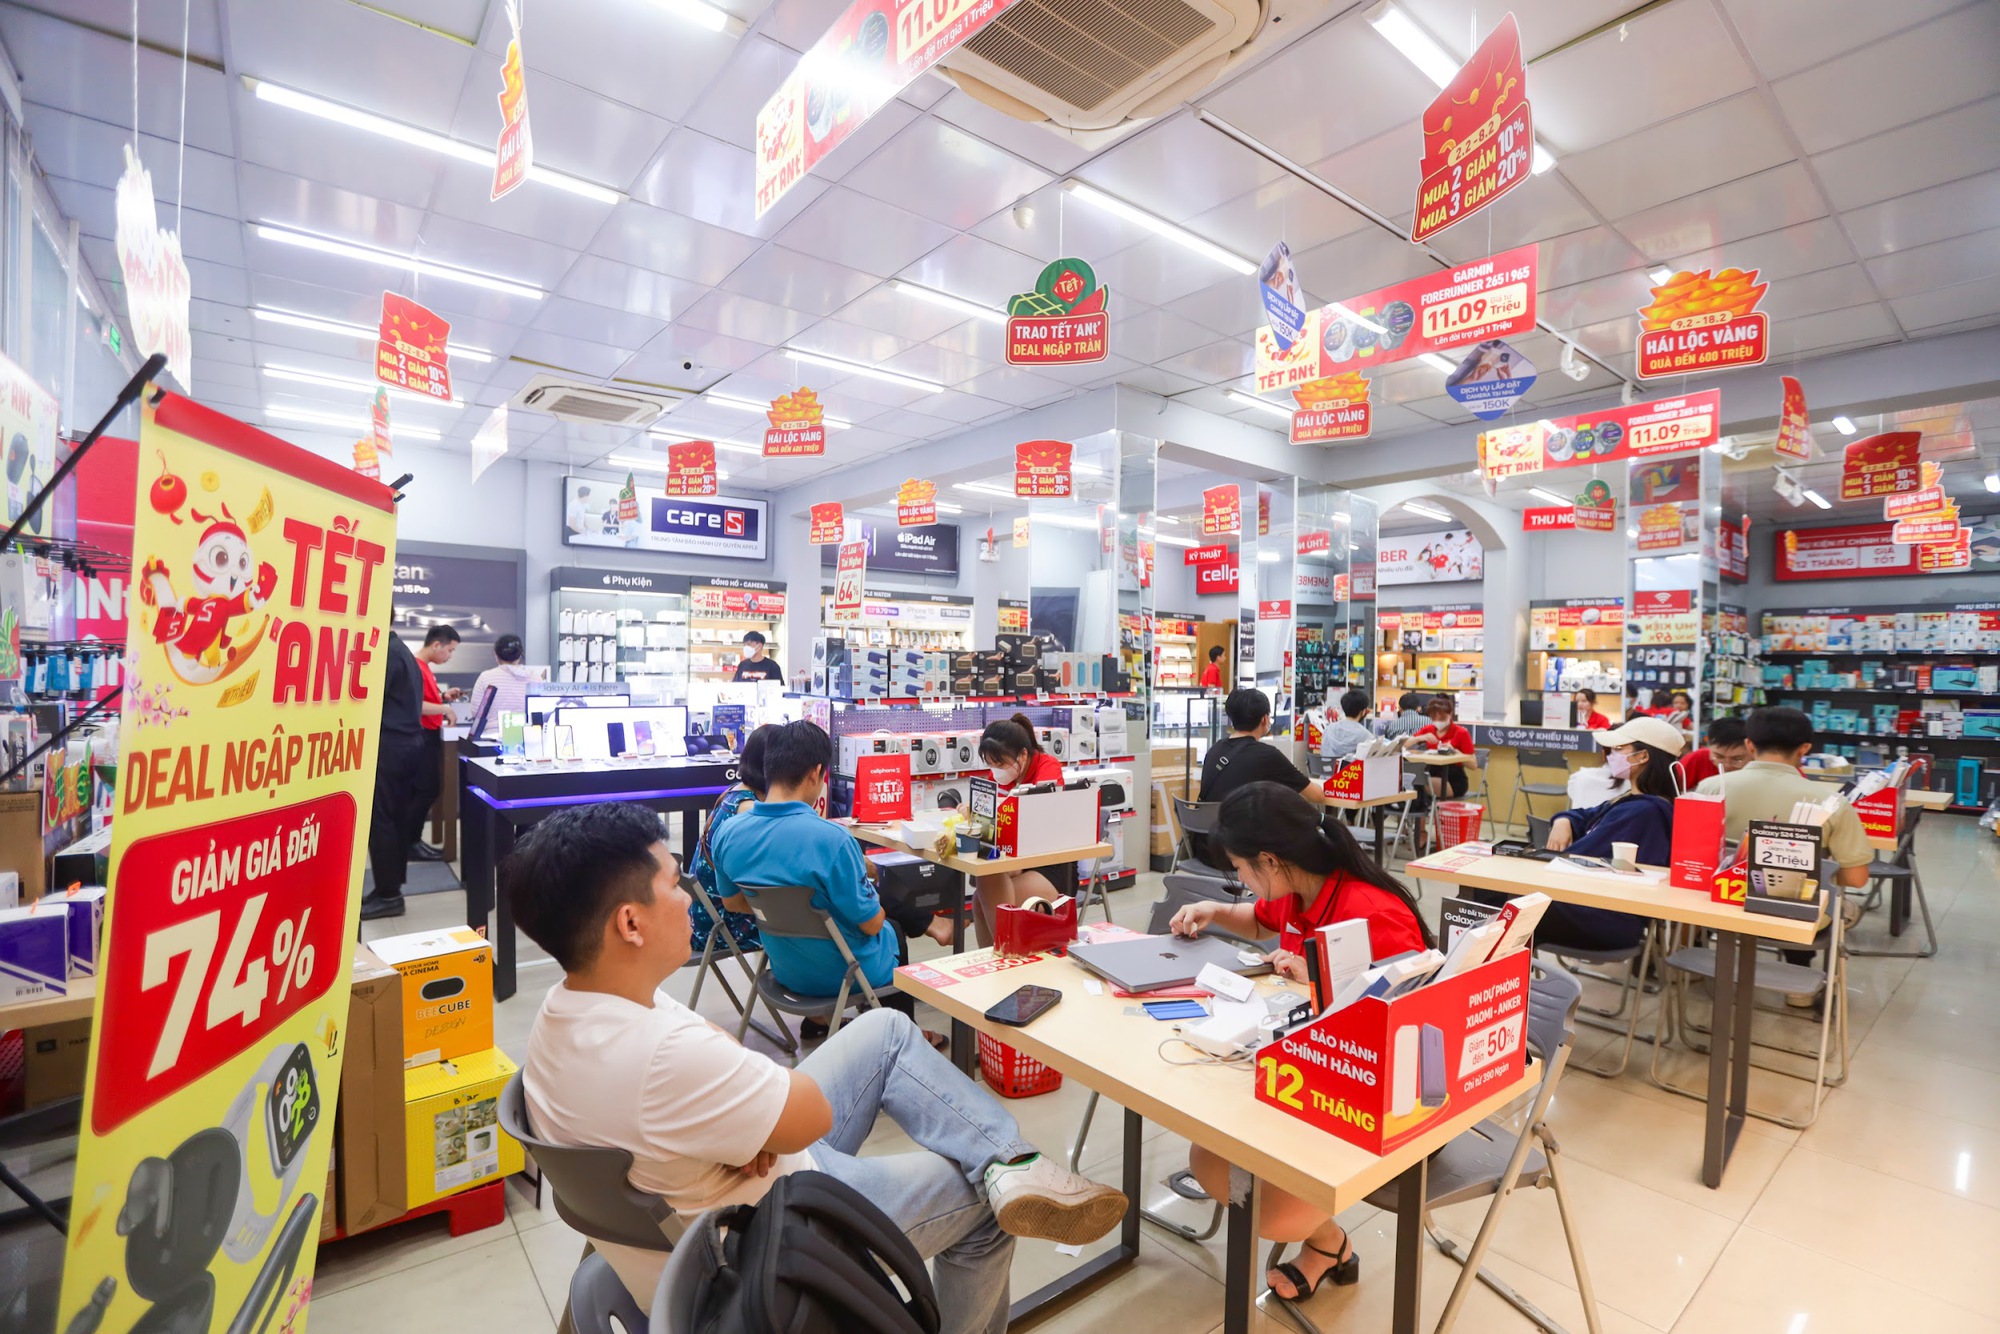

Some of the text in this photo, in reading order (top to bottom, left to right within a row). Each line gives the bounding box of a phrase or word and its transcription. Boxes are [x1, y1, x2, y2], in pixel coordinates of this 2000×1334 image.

[950, 0, 994, 42] giá Triệu
[1423, 117, 1525, 210] MUA 2 GIẢM 10%
[1420, 145, 1527, 234] MUA 3 GIẢM 20%
[1454, 262, 1494, 284] GARMIN
[1060, 277, 1078, 294] Tết
[1421, 266, 1530, 306] FORERUNNER 265 965
[1428, 298, 1521, 332] 11.09 Triệu
[1015, 321, 1072, 339] TRAO TẾT
[1434, 320, 1512, 346] Lên Triệu
[1014, 338, 1101, 358] DEAL NGẬP TRÀN
[1646, 324, 1758, 355] HÁI LỘC VÀNG
[380, 350, 446, 380] MUA 2 GIẢM 10%
[1650, 345, 1754, 370] QUÀ ĐẾN 600 TRIỆU
[380, 365, 448, 396] MUA 3 GIẢM 20%
[1259, 367, 1285, 390] TẾT
[1483, 399, 1510, 410] 150K
[1296, 408, 1364, 428] HÁI LỘC VÀNG
[768, 430, 822, 444] HÁI LỘC VÀNG
[1634, 424, 1680, 444] 11.09
[1489, 462, 1514, 476] TẾT
[1873, 468, 1916, 482] GIẢM 10%
[688, 476, 702, 484] GIẢM
[702, 474, 714, 484] 10%
[1038, 475, 1054, 484] GIẢM
[1054, 474, 1068, 484] 10%
[1873, 480, 1917, 494] GIẢM 20%
[688, 485, 702, 494] GIẢM
[702, 484, 715, 494] 20%
[1038, 485, 1054, 494] GIẢM
[1054, 484, 1069, 494] 20%
[1531, 515, 1554, 525] THU
[904, 533, 936, 545] iPad Air
[1189, 549, 1222, 560] KỸ THUẬT
[1874, 547, 1894, 555] GIÁ
[283, 515, 386, 618] TẾT
[1812, 558, 1853, 567] THÁNG
[1874, 556, 1895, 564] TỐT
[403, 585, 430, 594] 15 Pro
[612, 576, 652, 588] Phụ Kiện
[839, 580, 859, 602] 64%
[572, 684, 618, 692] AI here
[1508, 729, 1579, 744] GÓP KHIẾU NẠI
[1545, 742, 1578, 750] 1800.2063
[124, 718, 366, 816] DEAL NGẬP TRÀN
[1342, 771, 1359, 780] CỰC
[875, 779, 898, 792] TẾT
[1333, 777, 1350, 789] TỐT
[1003, 803, 1014, 813] GIÁ
[1752, 829, 1779, 837] Galaxy
[171, 813, 322, 906] GIẢM GIÁ ĐẾN
[1762, 851, 1808, 867] 2 Triệu
[1715, 878, 1746, 902] 12
[410, 966, 439, 976] CINEMA
[141, 892, 316, 1082] 74%
[1468, 977, 1520, 1008] PIN DỰ PHÒNG
[1466, 995, 1521, 1029] XIAOMI ANKER
[425, 1016, 466, 1039] DESIGN
[1310, 1028, 1378, 1064] BẢO HÀNH
[1468, 1038, 1485, 1053] Giảm
[1487, 1026, 1515, 1056] 50%
[1282, 1038, 1376, 1087] CHÍNH HÃNG
[1472, 1051, 1485, 1066] đến
[1464, 1062, 1509, 1093] Chỉ từ 390 Ngàn
[1260, 1055, 1376, 1133] 12 THÁNG
